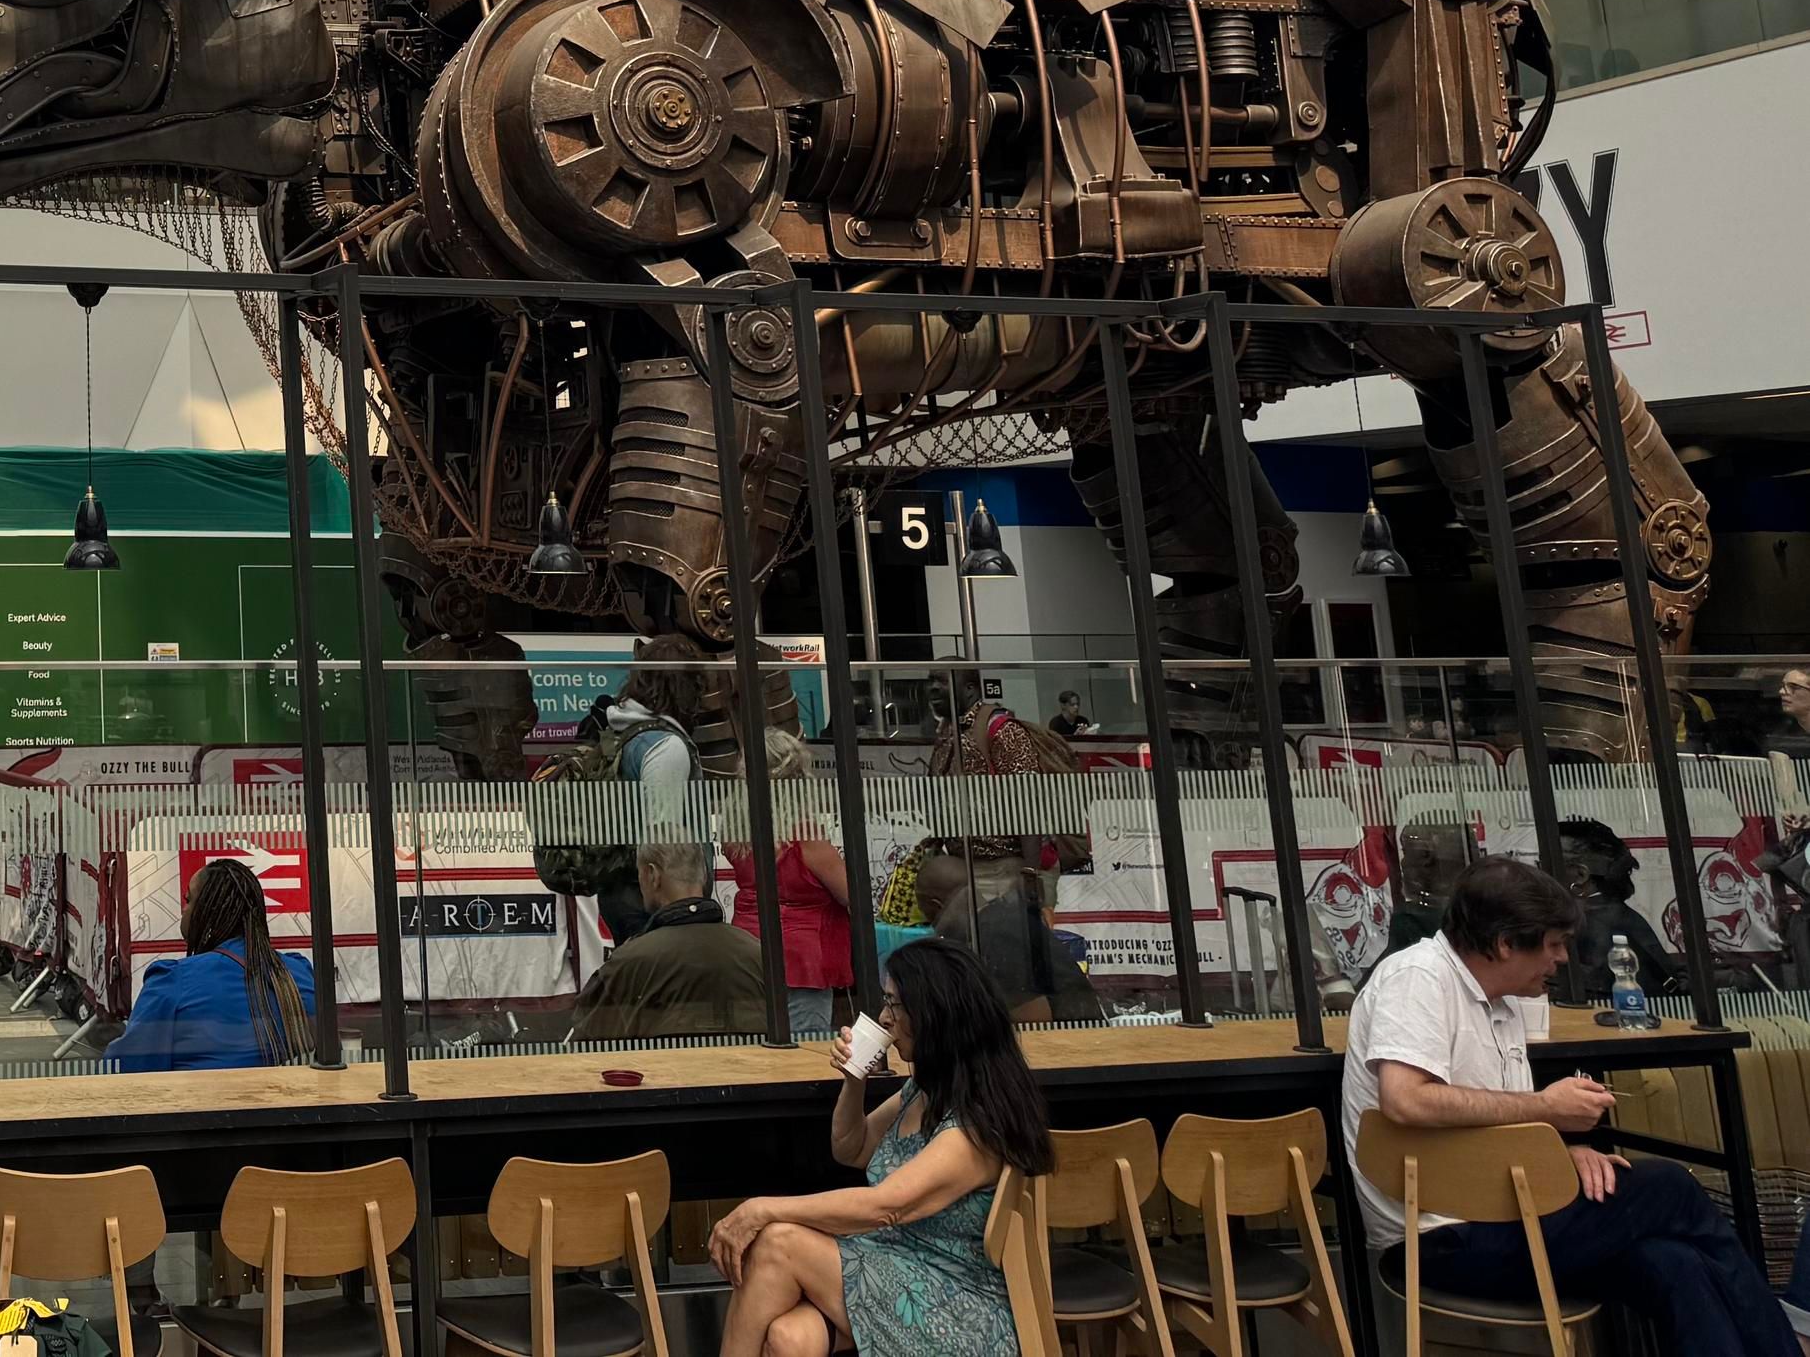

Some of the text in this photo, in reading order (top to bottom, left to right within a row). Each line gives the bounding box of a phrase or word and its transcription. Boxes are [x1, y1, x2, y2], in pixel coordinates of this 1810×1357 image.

[901, 507, 930, 550] 5
[7, 612, 67, 623] Expert Advice
[22, 641, 53, 652] Beauty
[28, 671, 50, 679] Food
[587, 671, 608, 687] to
[985, 681, 1002, 695] 5a
[15, 697, 62, 707] Vitamins &
[10, 709, 68, 719] Supplements
[532, 727, 547, 739] for
[548, 726, 579, 738] travell
[5, 736, 74, 746] Sports Nutrition
[100, 761, 190, 774] OZZY THE BULL
[435, 842, 534, 855] Combined Autho
[1086, 939, 1148, 950] NTRODUCING
[1127, 954, 1175, 965] MECHANIC
